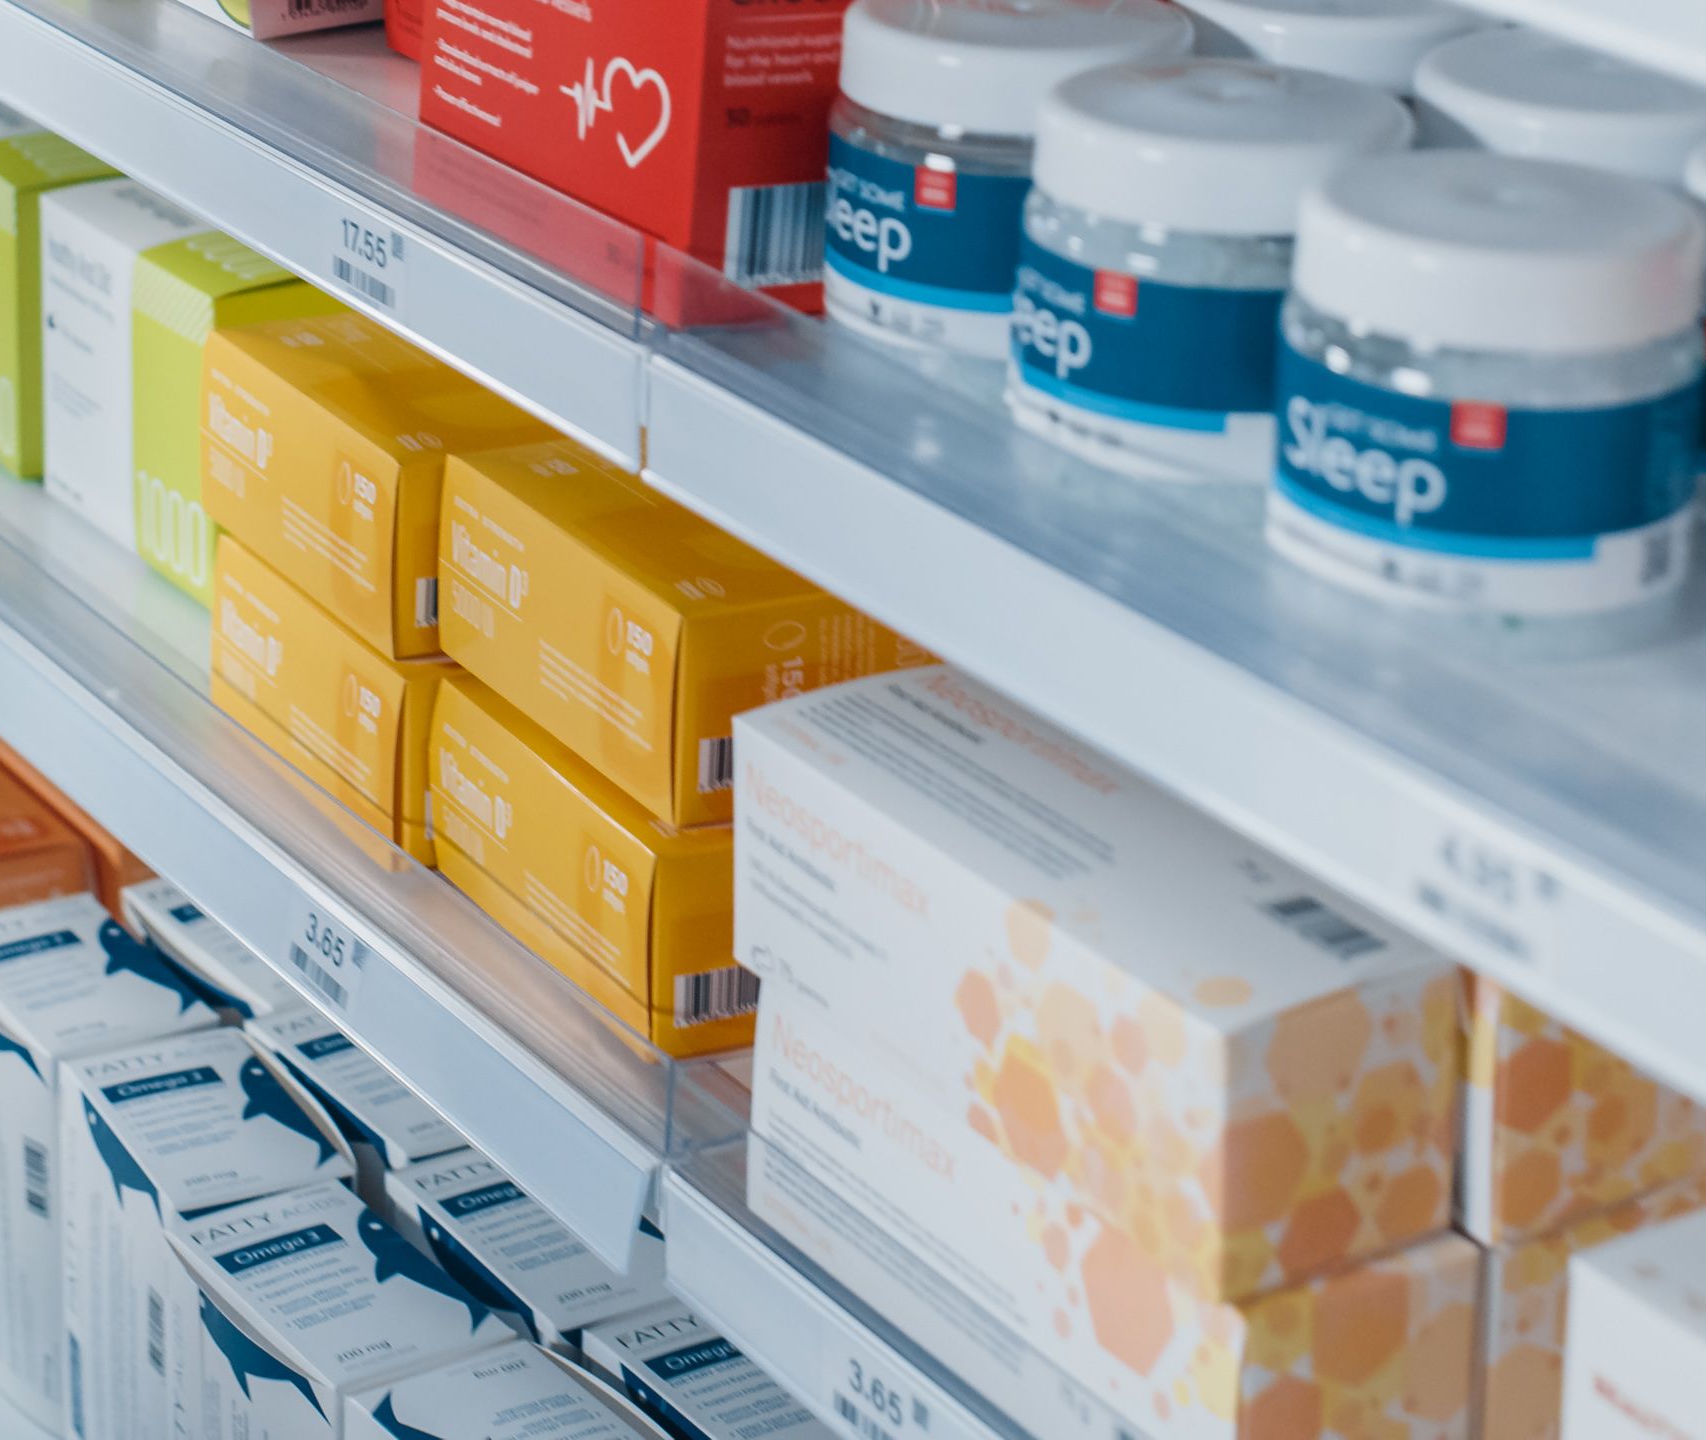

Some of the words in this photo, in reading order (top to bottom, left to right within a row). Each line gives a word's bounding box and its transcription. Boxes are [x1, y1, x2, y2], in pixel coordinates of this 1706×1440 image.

[340, 216, 388, 270] 17.55
[1011, 288, 1094, 380] eep
[208, 390, 256, 462] Vitamin
[1283, 395, 1448, 529] Sleep
[137, 469, 208, 588] 1000
[450, 518, 508, 602] Vitamin
[626, 619, 654, 657] 150
[439, 747, 493, 829] Vitamin
[745, 762, 931, 918] Neosportimax
[603, 858, 629, 898] 150
[305, 911, 345, 969] 3.65
[83, 1051, 165, 1080] FATTY
[116, 1075, 189, 1108] Omega
[773, 1011, 956, 1184] Neosportimax
[415, 1161, 495, 1191] FATTY
[190, 1212, 272, 1246] FATTY
[280, 1195, 347, 1220] ACIDS
[232, 1236, 307, 1266] Omega
[365, 1338, 392, 1357] mg
[614, 1314, 700, 1349] FATTY
[849, 1358, 904, 1427] 3.65
